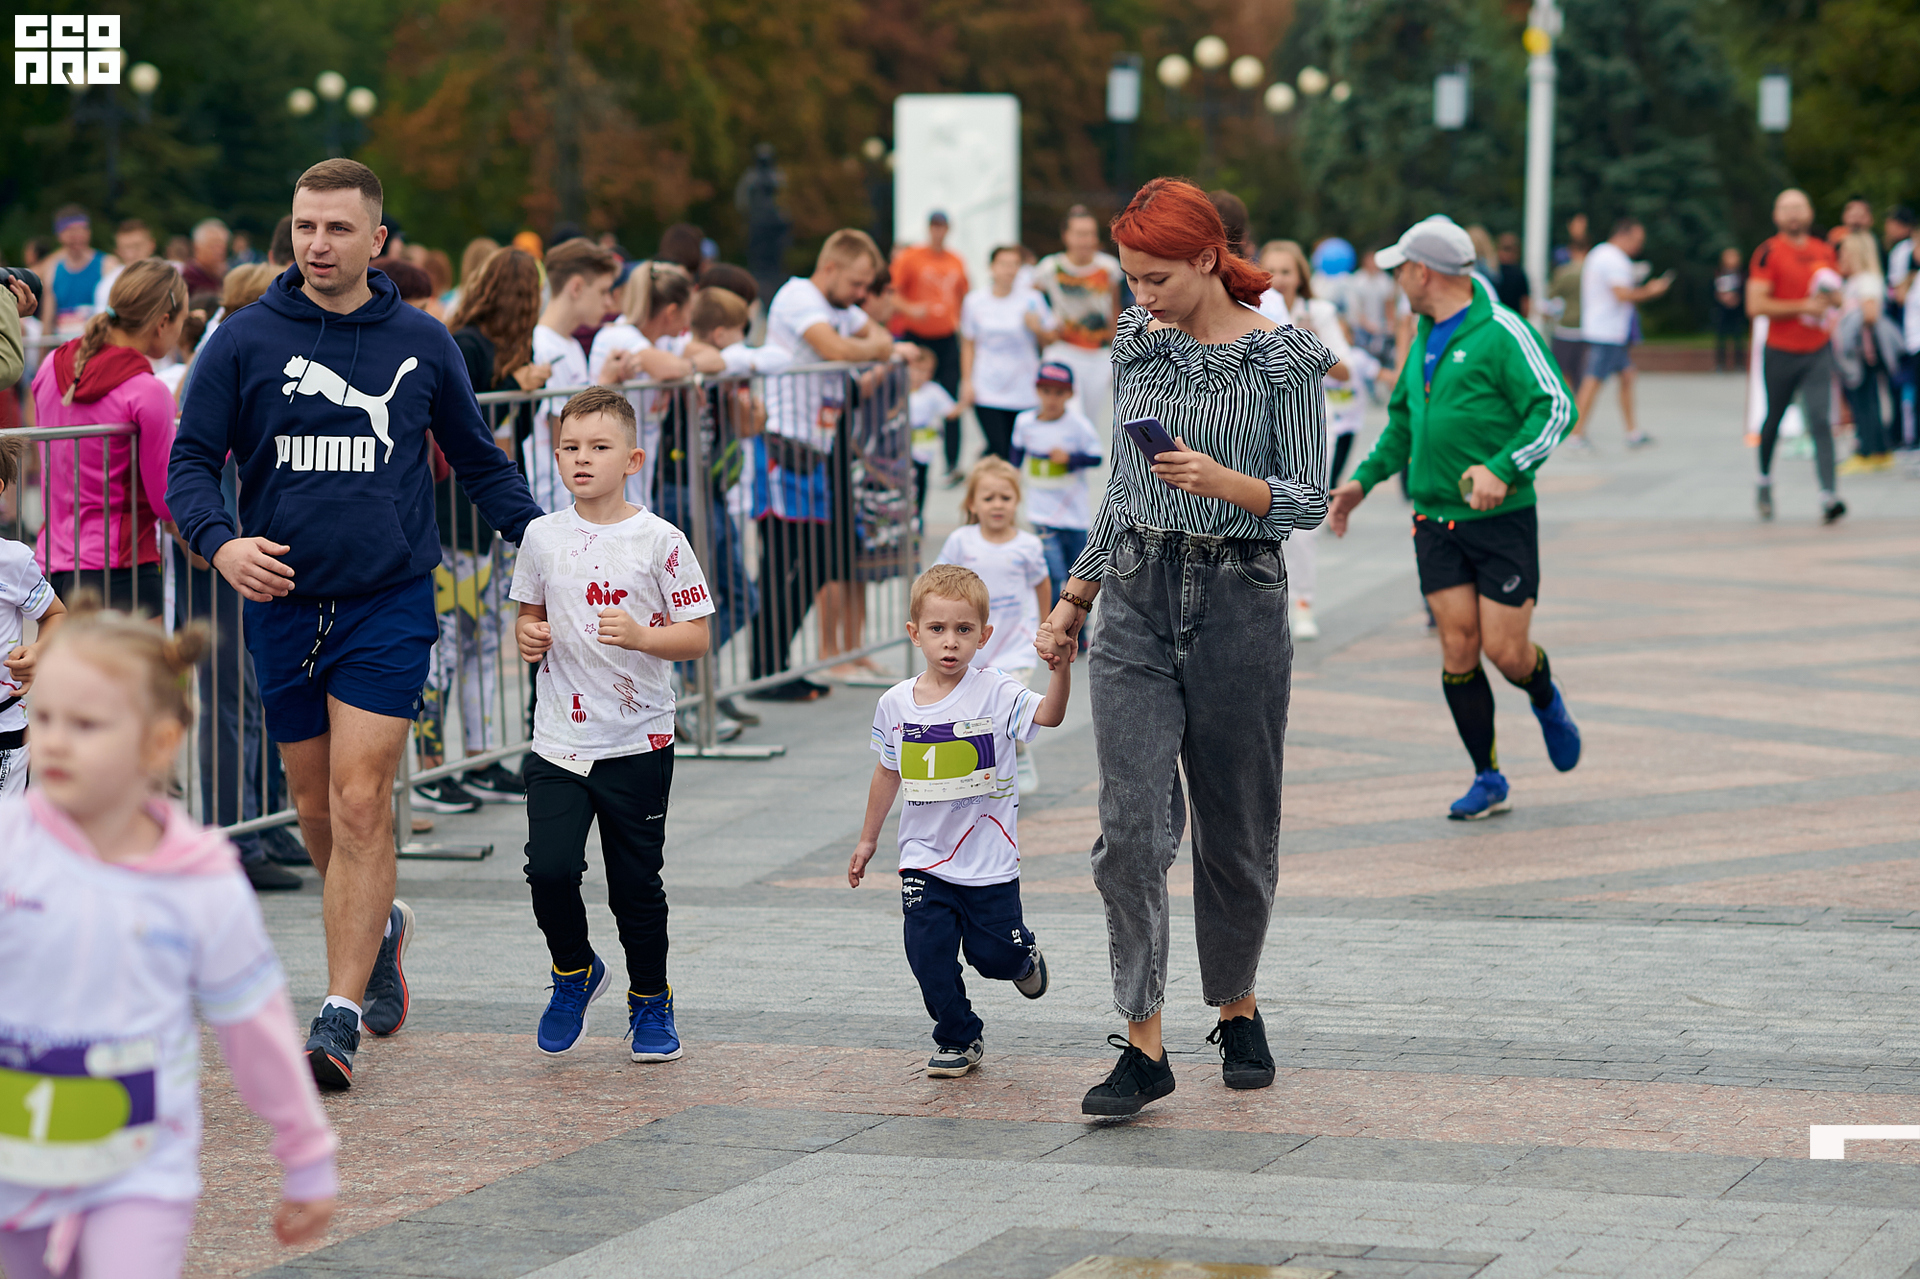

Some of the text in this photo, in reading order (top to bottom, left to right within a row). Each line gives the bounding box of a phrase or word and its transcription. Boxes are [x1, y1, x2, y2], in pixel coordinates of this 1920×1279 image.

[274, 435, 376, 472] PUMA
[585, 581, 628, 606] Air
[671, 583, 708, 608] 1985
[922, 745, 936, 778] 1
[23, 1077, 55, 1143] 1
